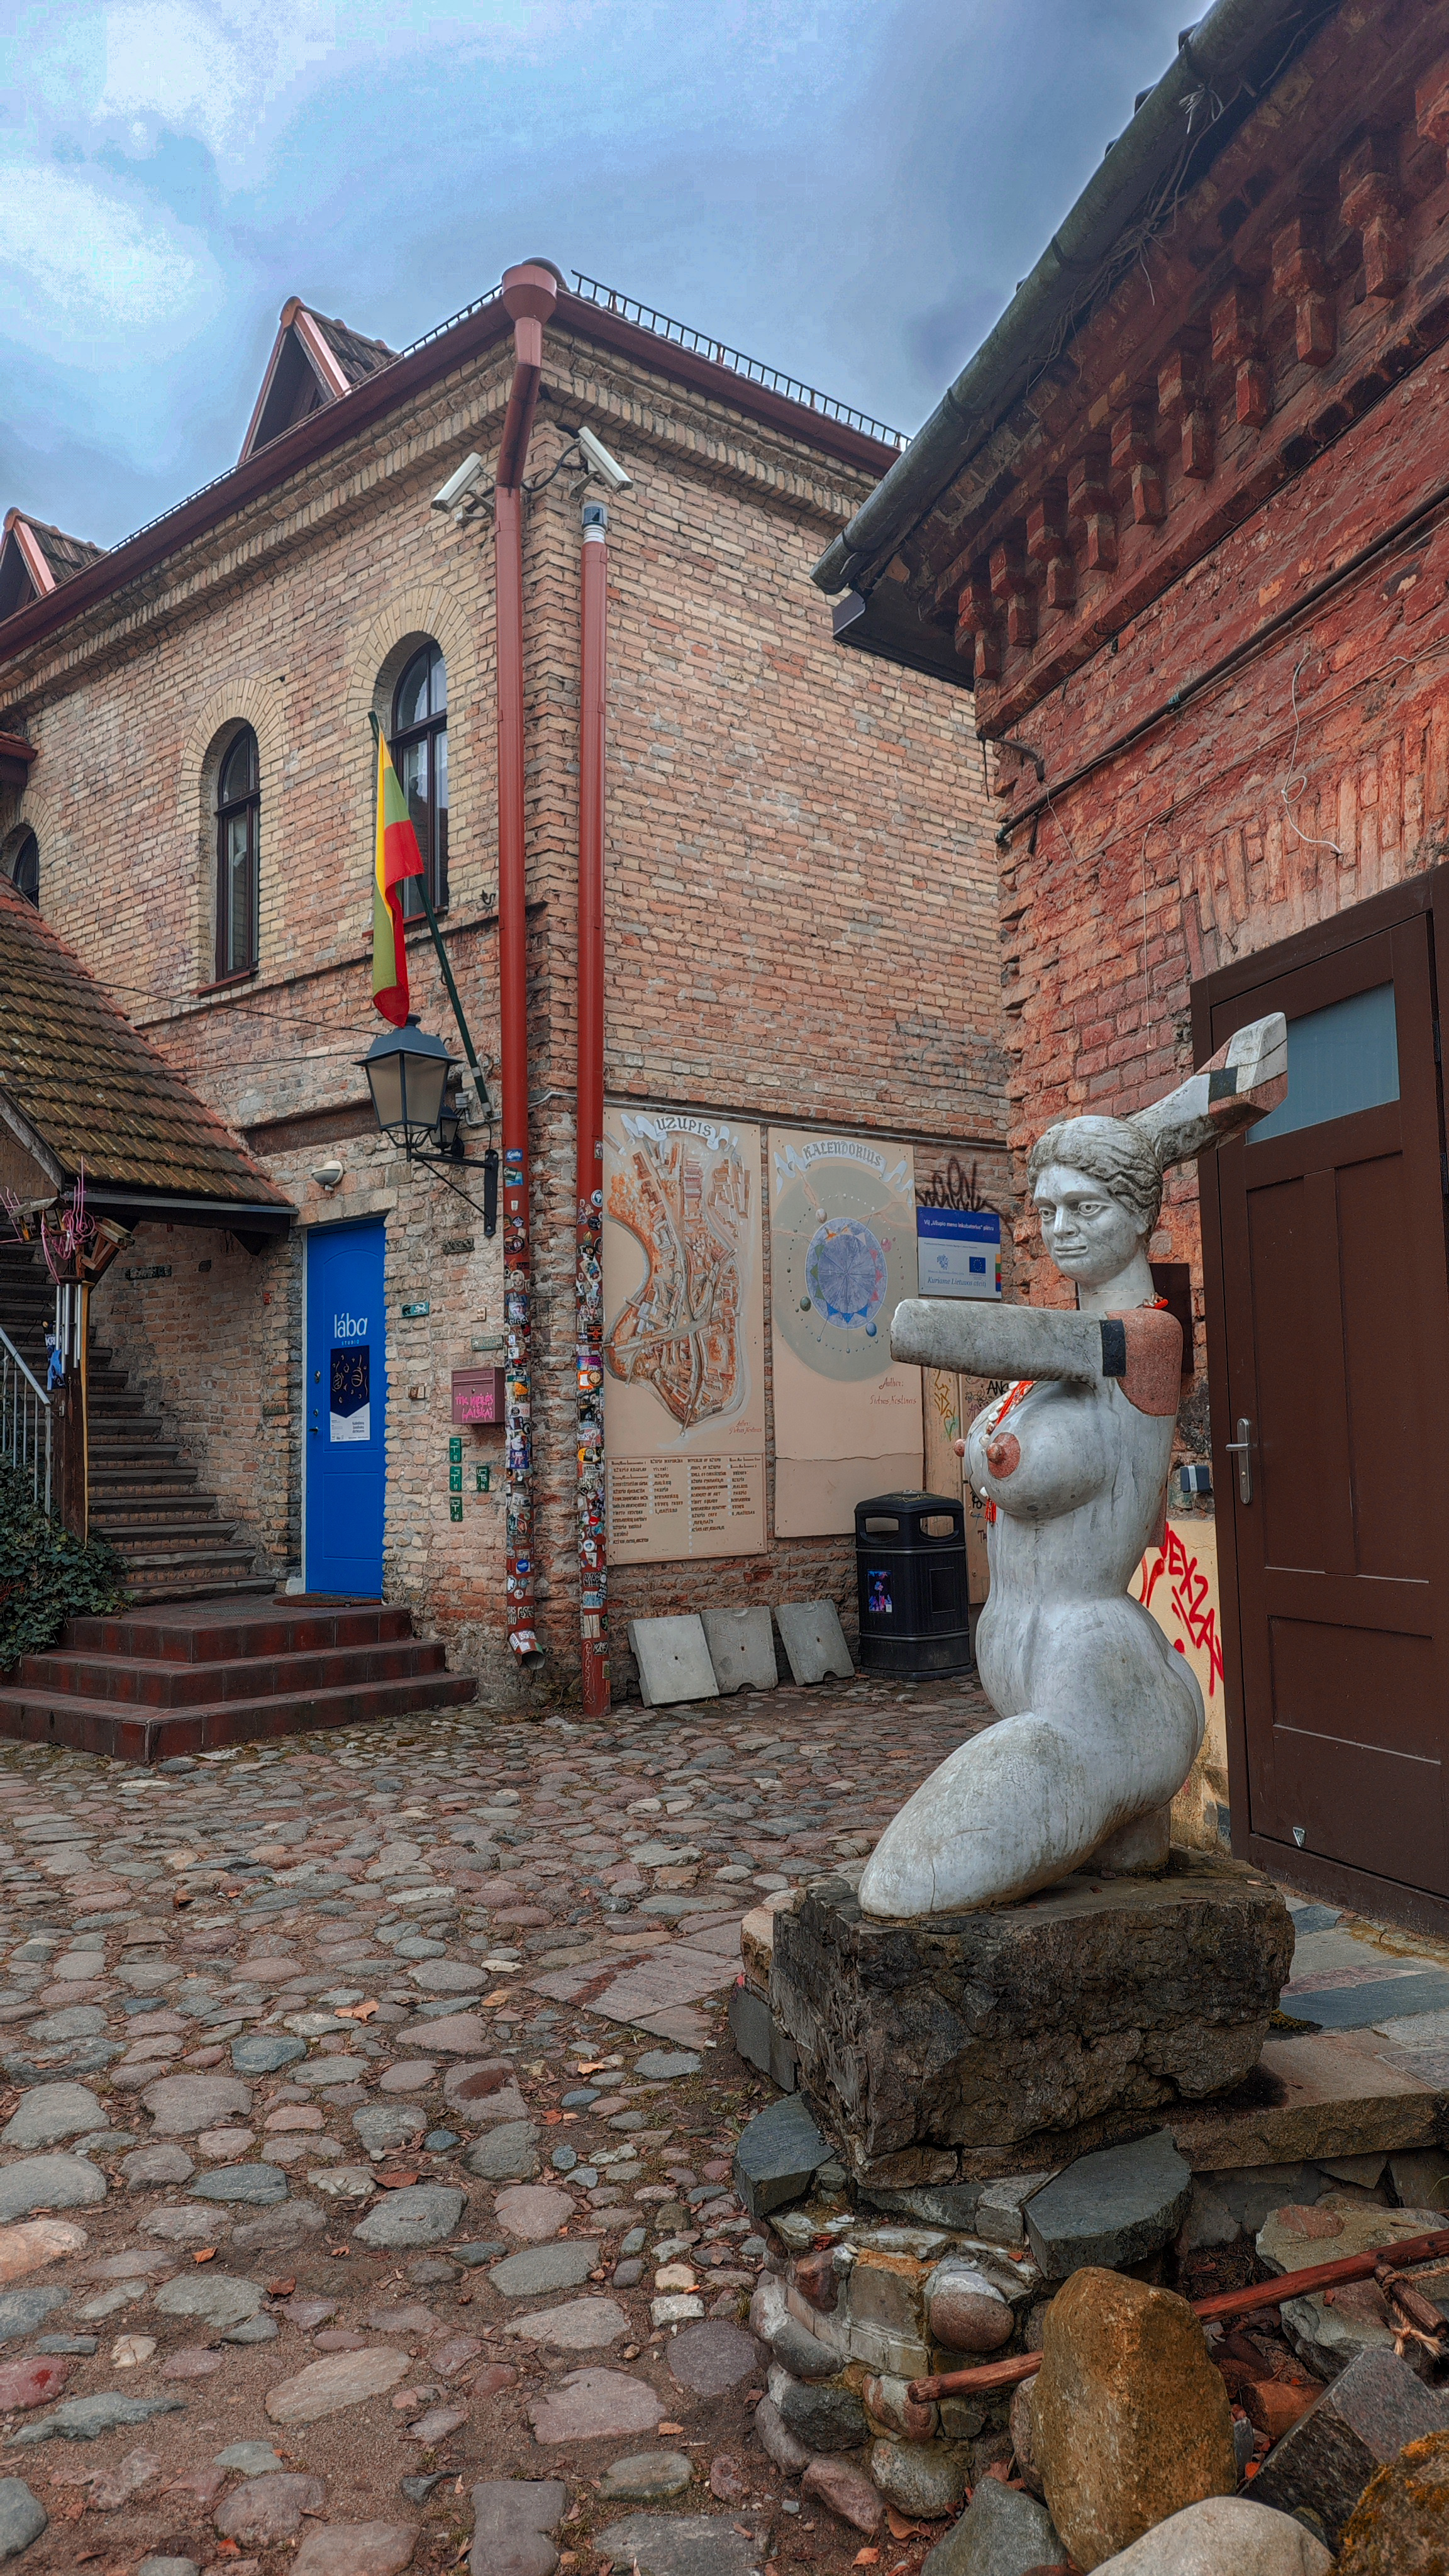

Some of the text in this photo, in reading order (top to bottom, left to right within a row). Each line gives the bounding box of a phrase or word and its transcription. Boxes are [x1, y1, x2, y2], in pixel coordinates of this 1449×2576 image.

[802, 1140, 882, 1167] KALENDORIUS
[927, 1276, 951, 1285] Kuriame
[951, 1277, 973, 1286] Lietuvos
